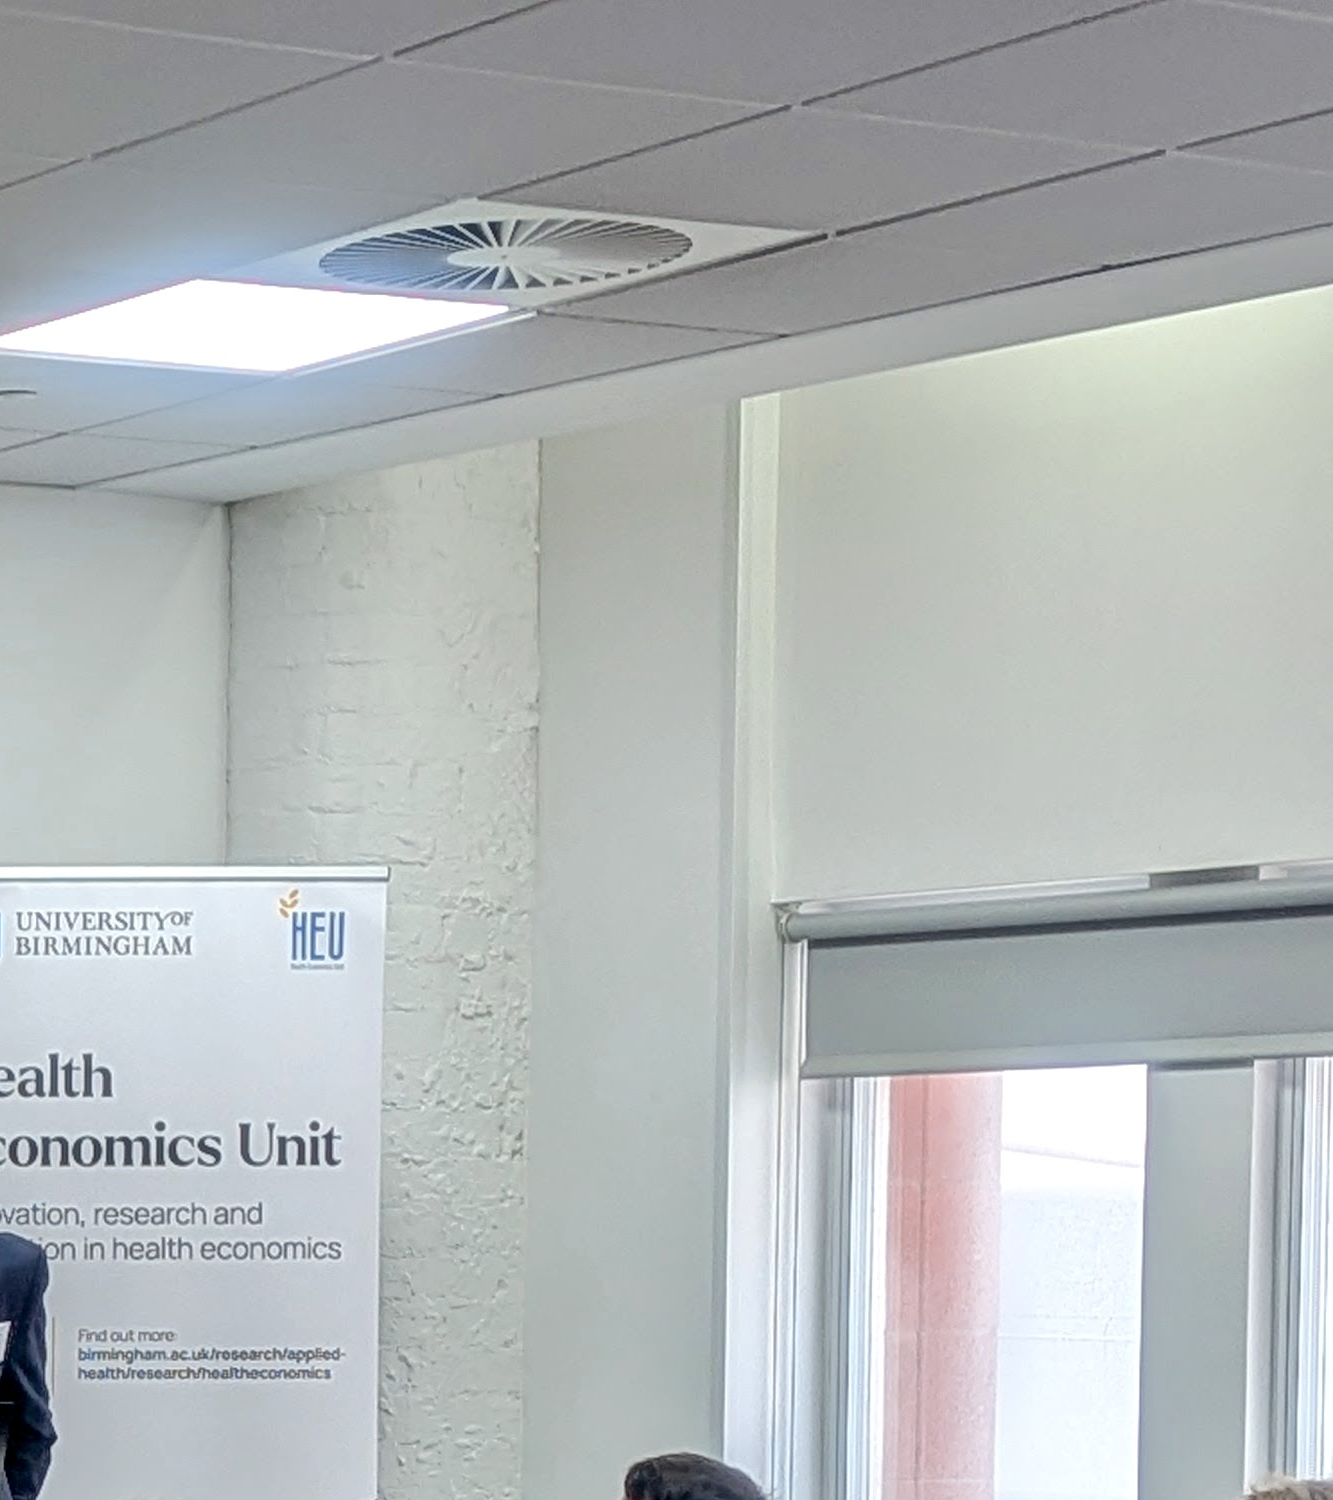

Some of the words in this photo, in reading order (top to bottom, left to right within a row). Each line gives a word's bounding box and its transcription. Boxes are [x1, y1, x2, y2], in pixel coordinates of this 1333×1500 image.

[15, 911, 166, 932] UNIVERSITY
[15, 935, 194, 957] BIRMINGHAM
[291, 911, 346, 962] HEU
[238, 1120, 343, 1169] Unit
[94, 1203, 208, 1226] research
[213, 1202, 264, 1226] and
[83, 1236, 106, 1261] in
[112, 1237, 194, 1261] health
[199, 1236, 343, 1262] economics
[78, 1329, 108, 1343] Find
[110, 1329, 135, 1343] out
